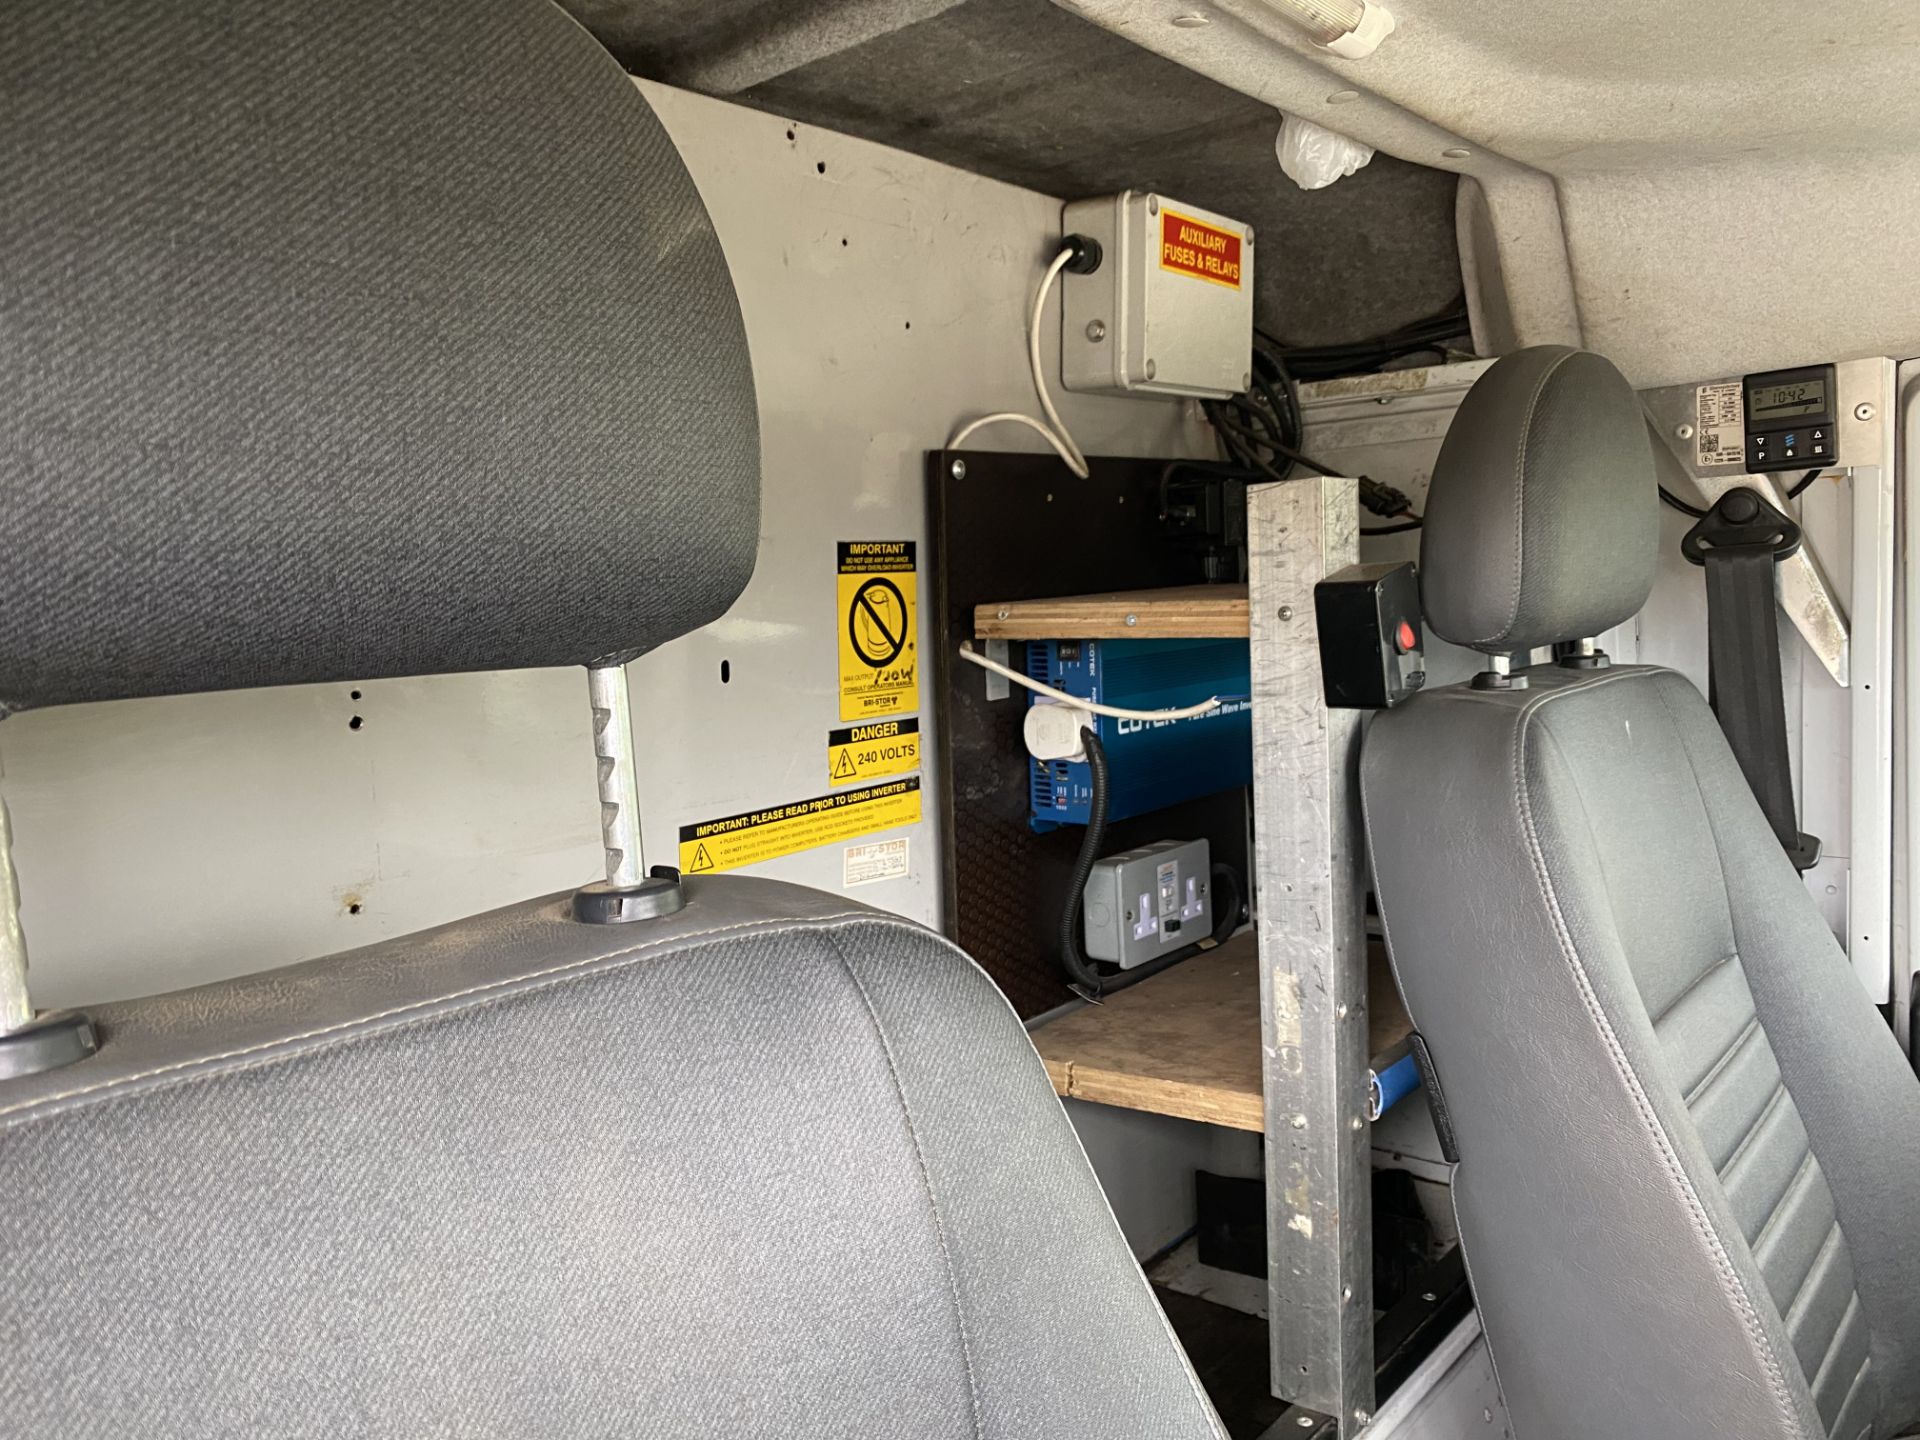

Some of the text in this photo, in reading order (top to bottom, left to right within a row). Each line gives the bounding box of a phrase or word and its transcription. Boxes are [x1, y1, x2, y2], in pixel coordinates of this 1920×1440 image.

[1179, 225, 1227, 254] AUXILIARY
[1164, 243, 1239, 279] FUSES & RELAYS
[1758, 452, 1765, 460] P
[850, 544, 905, 555] IMPORTANT
[864, 696, 891, 707] BRI-STOR
[851, 722, 898, 742] DANGER
[857, 744, 915, 765] 240 VOLTS
[696, 782, 906, 836] IMPORTANT: PLEASE READ PRIOR TO USING INVERTER
